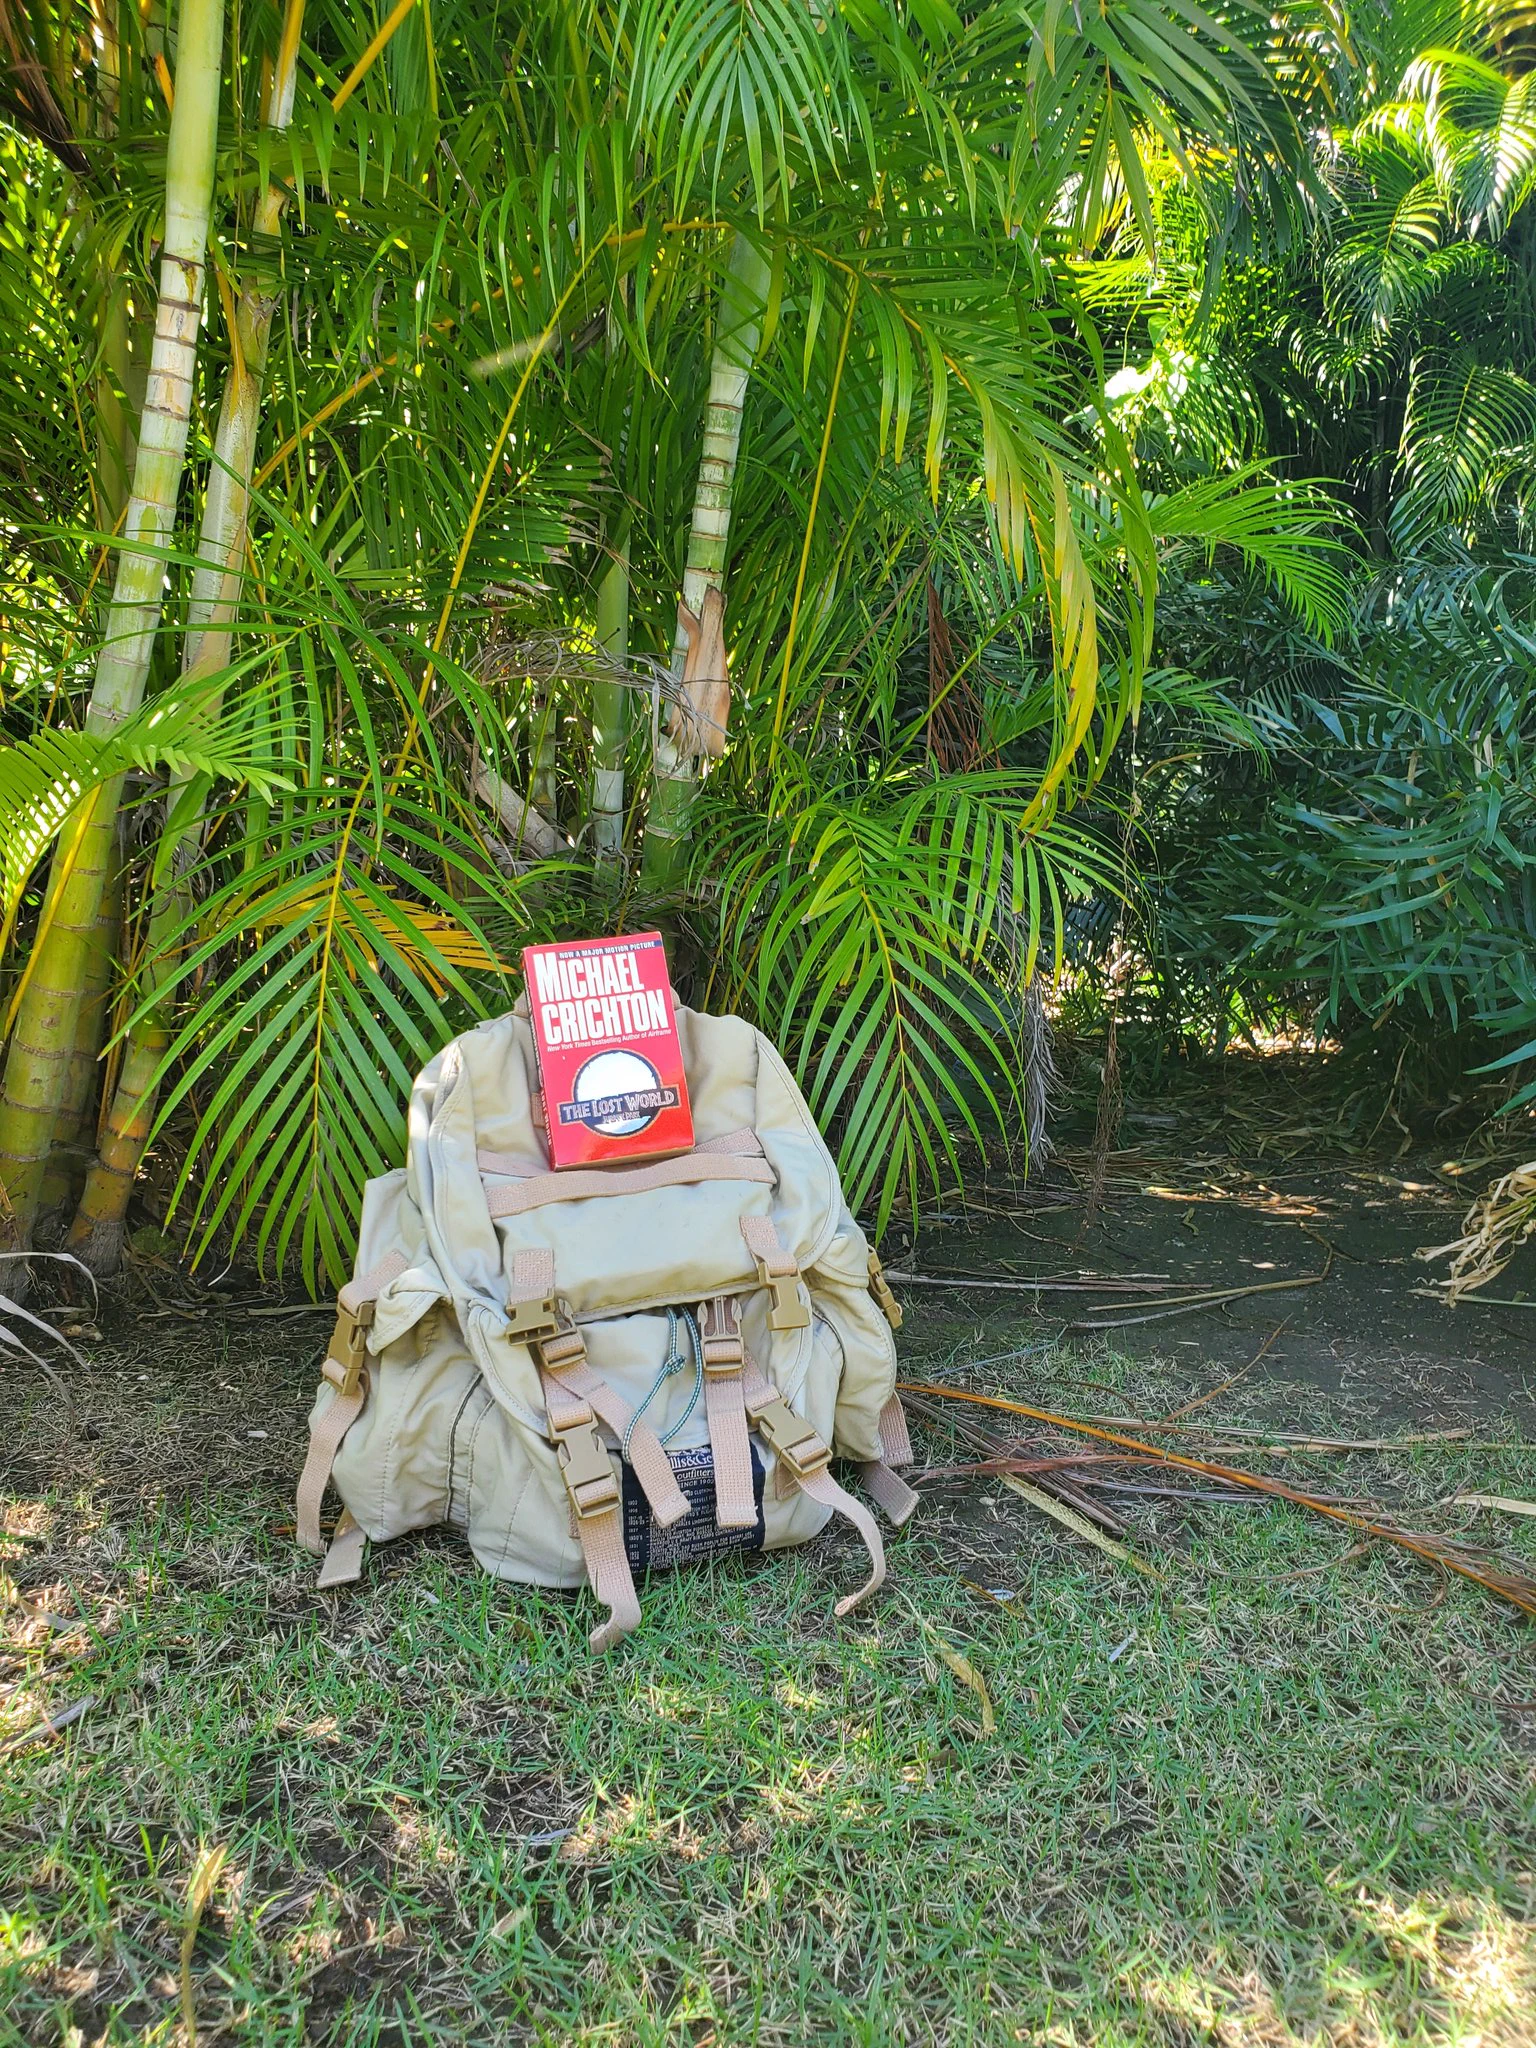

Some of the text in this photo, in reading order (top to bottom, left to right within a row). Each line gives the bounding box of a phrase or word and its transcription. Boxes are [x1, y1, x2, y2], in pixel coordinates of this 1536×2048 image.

[559, 951, 574, 959] NOW
[582, 948, 603, 956] MAJOR
[604, 945, 629, 955] MOTION
[630, 941, 655, 951] PICTURE
[532, 952, 645, 1003] MICHAEL
[541, 989, 669, 1045] CRICHTON
[575, 1040, 591, 1048] Times
[592, 1036, 621, 1046] Bestselling
[622, 1033, 640, 1041] Author
[648, 1029, 672, 1038] Airframe
[563, 1090, 675, 1120] THE LOST WORLD
[677, 1469, 714, 1480] outfitters
